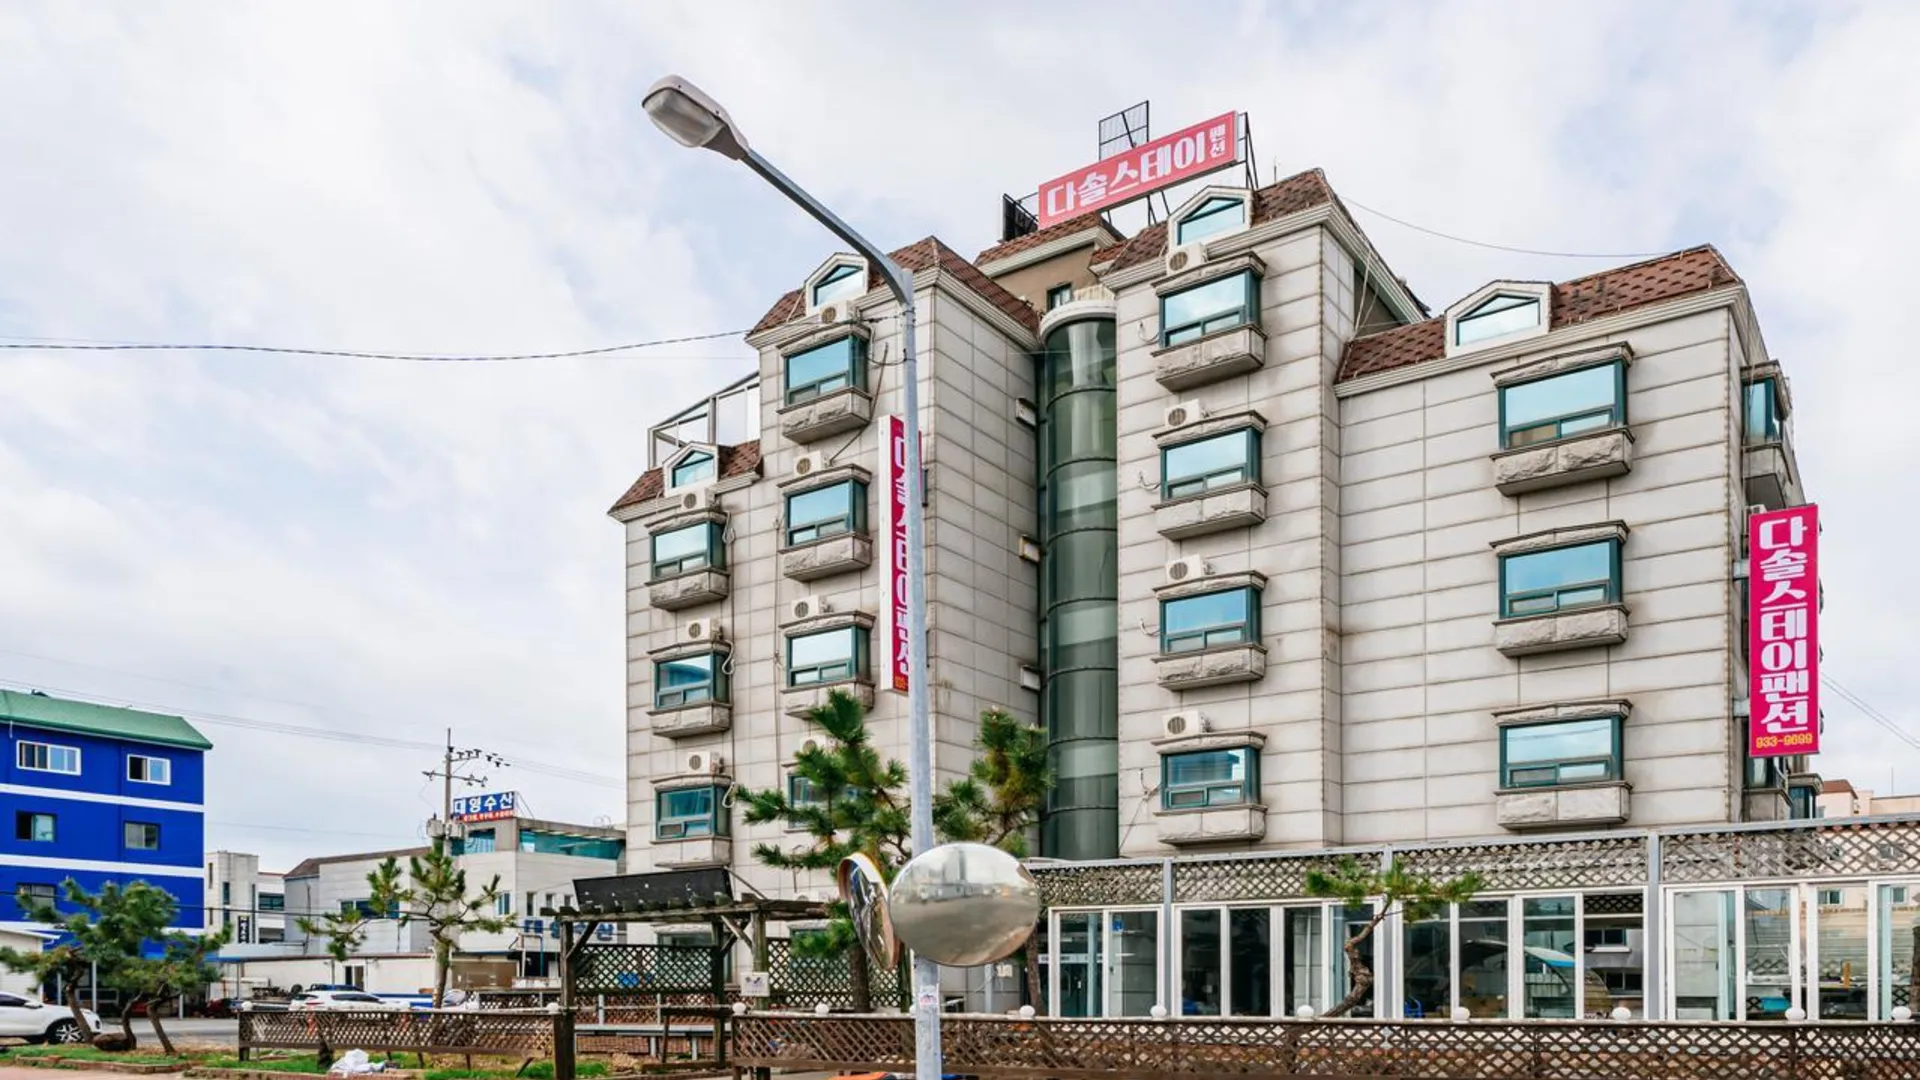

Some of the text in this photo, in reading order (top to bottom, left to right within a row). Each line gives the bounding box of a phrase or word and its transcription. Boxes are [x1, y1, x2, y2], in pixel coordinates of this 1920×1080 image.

[1047, 131, 1206, 217] 다솔스테이
[1759, 515, 1809, 734] 다솔스테이팬션
[454, 792, 513, 814] 대영수산
